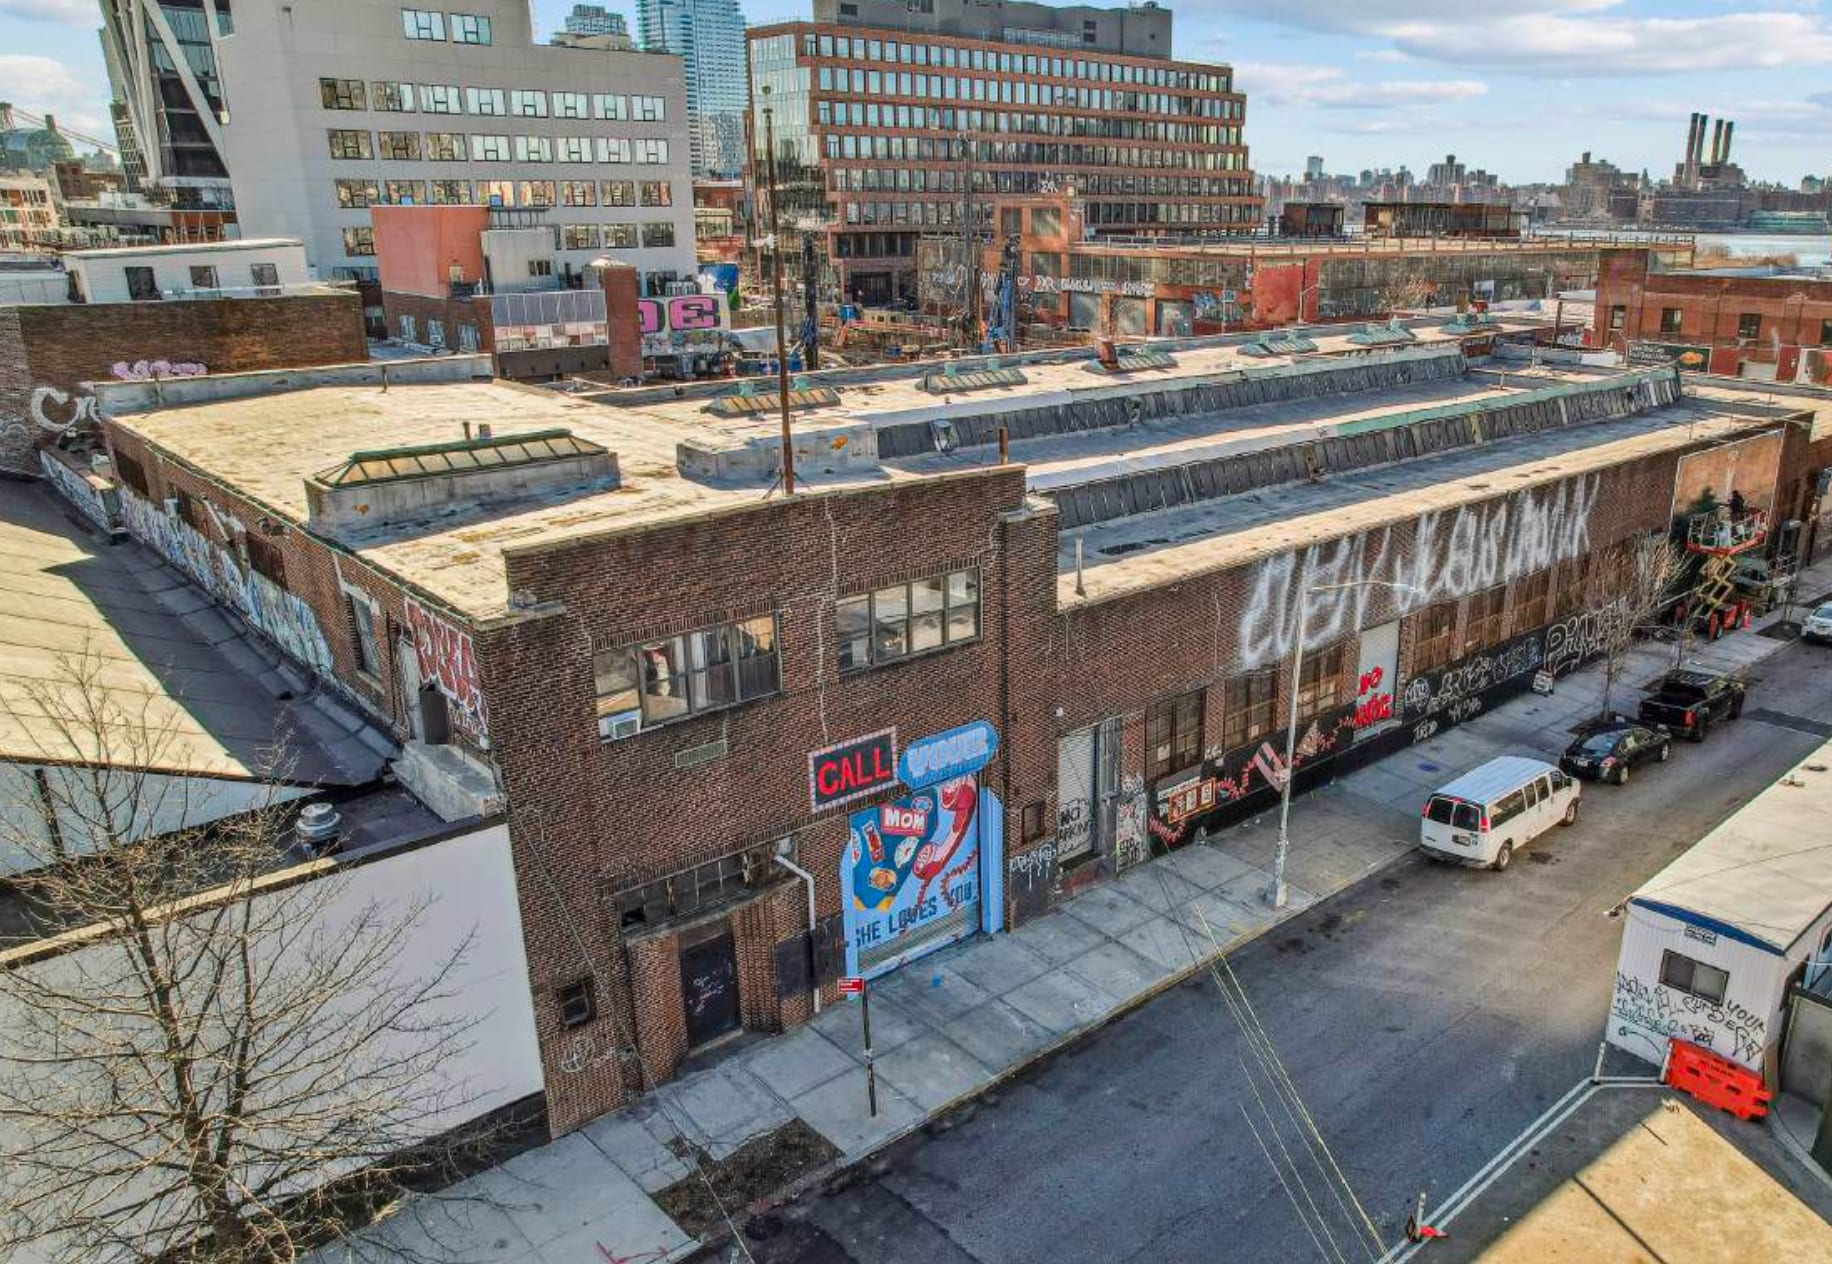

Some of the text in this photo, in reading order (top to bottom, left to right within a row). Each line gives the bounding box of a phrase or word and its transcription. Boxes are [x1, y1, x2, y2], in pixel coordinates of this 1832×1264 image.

[817, 746, 890, 796] CALL
[884, 807, 925, 831] MOM
[888, 896, 938, 932] LOVES
